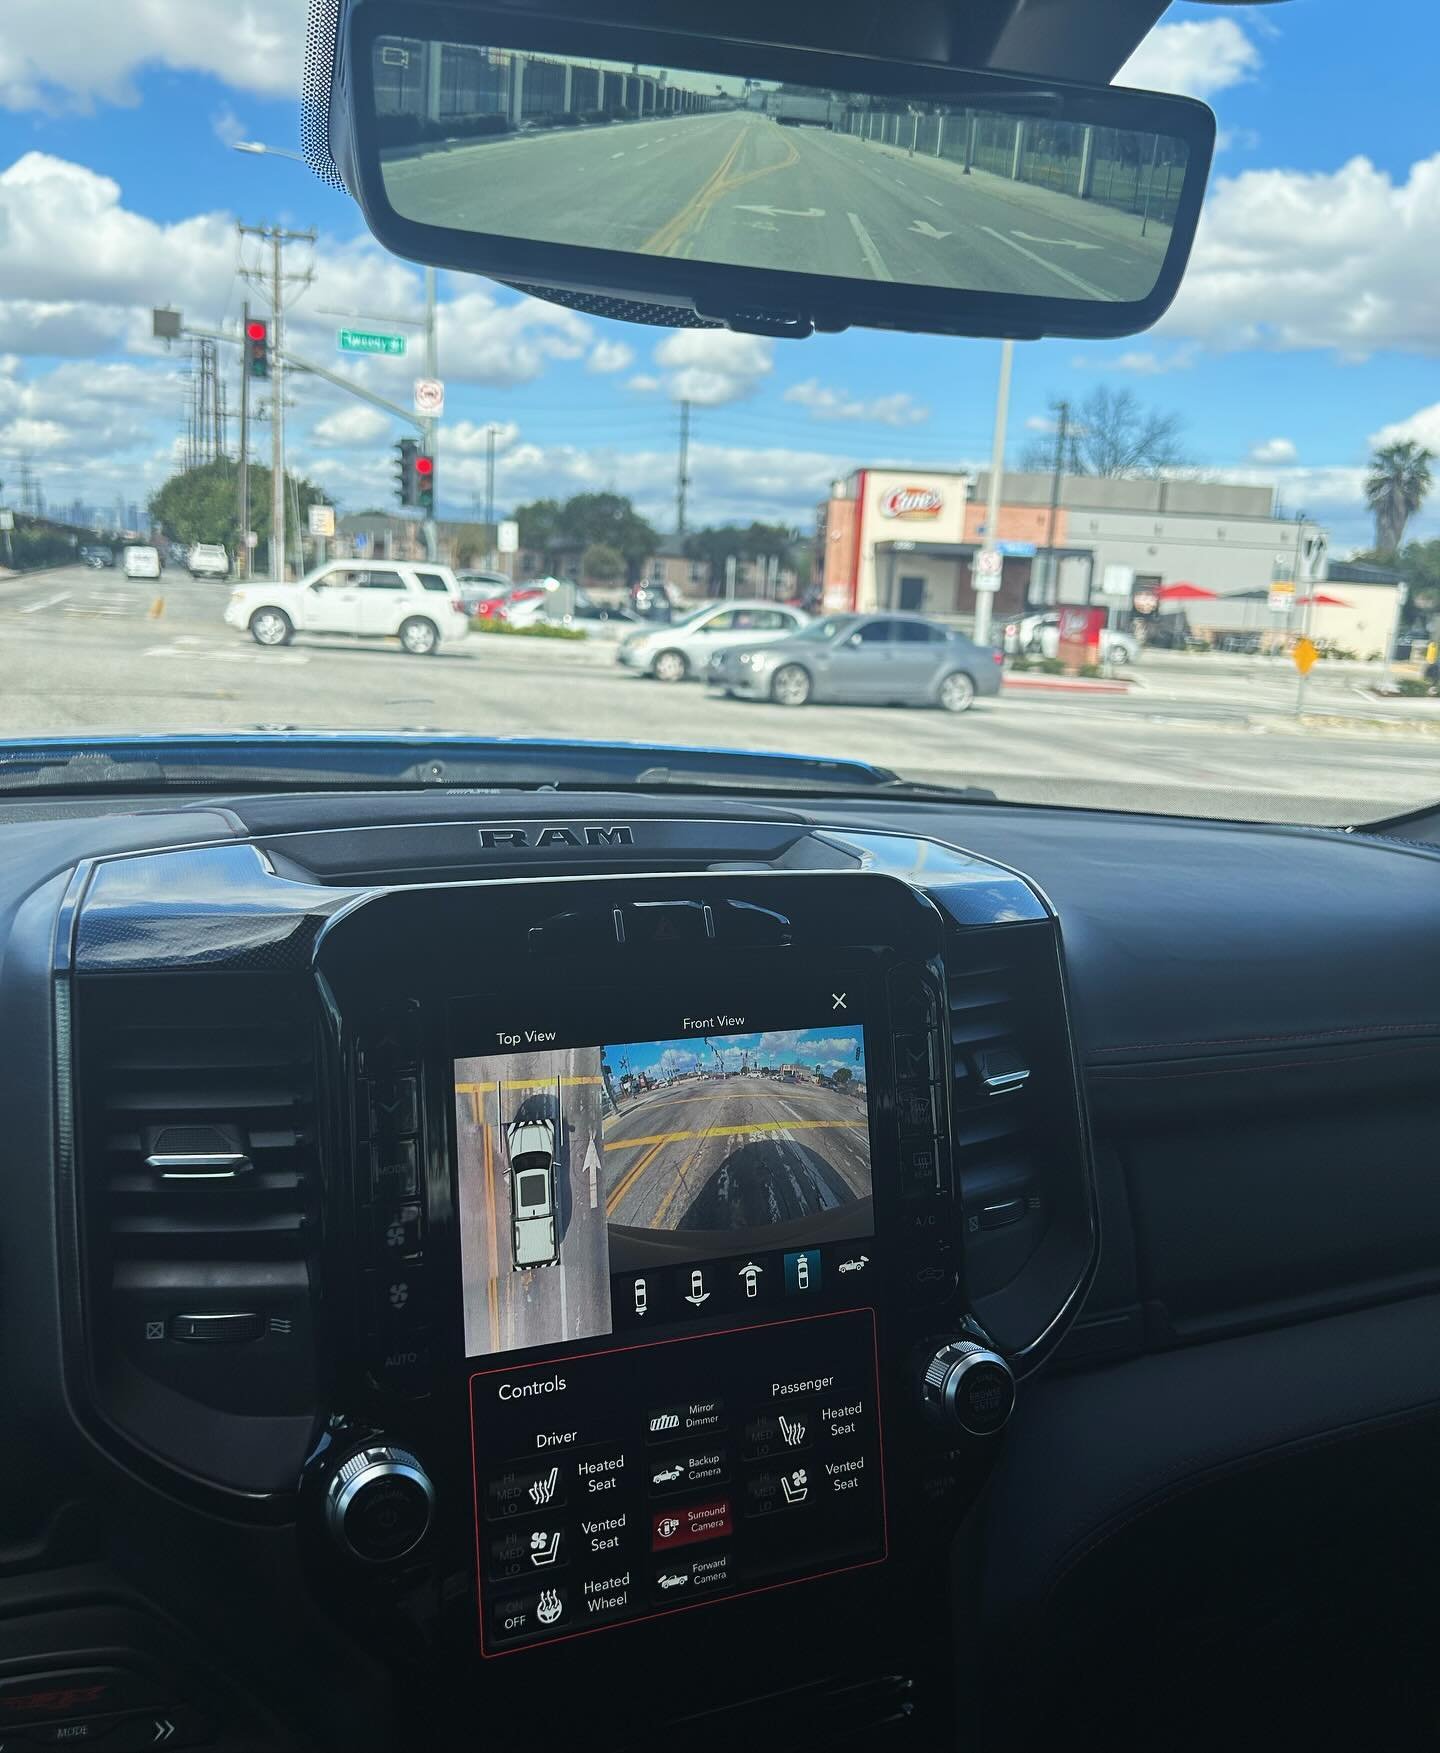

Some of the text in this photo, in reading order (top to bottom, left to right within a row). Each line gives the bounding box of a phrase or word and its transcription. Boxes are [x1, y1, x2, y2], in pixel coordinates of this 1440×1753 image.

[478, 826, 635, 848] RAM
[683, 1016, 745, 1030] Front View
[496, 1031, 556, 1047] Top View
[384, 1352, 417, 1367] AUTO
[498, 1375, 567, 1401] Controls
[771, 1376, 834, 1397] Passenger
[689, 1403, 715, 1415] Mirror
[821, 1401, 862, 1421] Heated
[685, 1415, 719, 1428] Dimmer
[830, 1422, 856, 1436] Seat
[536, 1430, 578, 1448] Driver
[578, 1455, 625, 1476] Heated
[688, 1455, 720, 1468] Backup
[825, 1456, 864, 1475] Vented
[688, 1468, 722, 1480] Camera
[588, 1477, 617, 1493] Seat
[833, 1477, 859, 1491] Seat
[687, 1503, 726, 1521] Surround
[581, 1513, 626, 1535] Vented
[691, 1519, 724, 1533] Camera
[591, 1536, 620, 1552] Seat
[692, 1555, 726, 1573] Forward
[584, 1572, 631, 1595] Heated
[693, 1571, 727, 1585] Camera
[587, 1591, 628, 1613] Wheel
[504, 1615, 527, 1630] OFF
